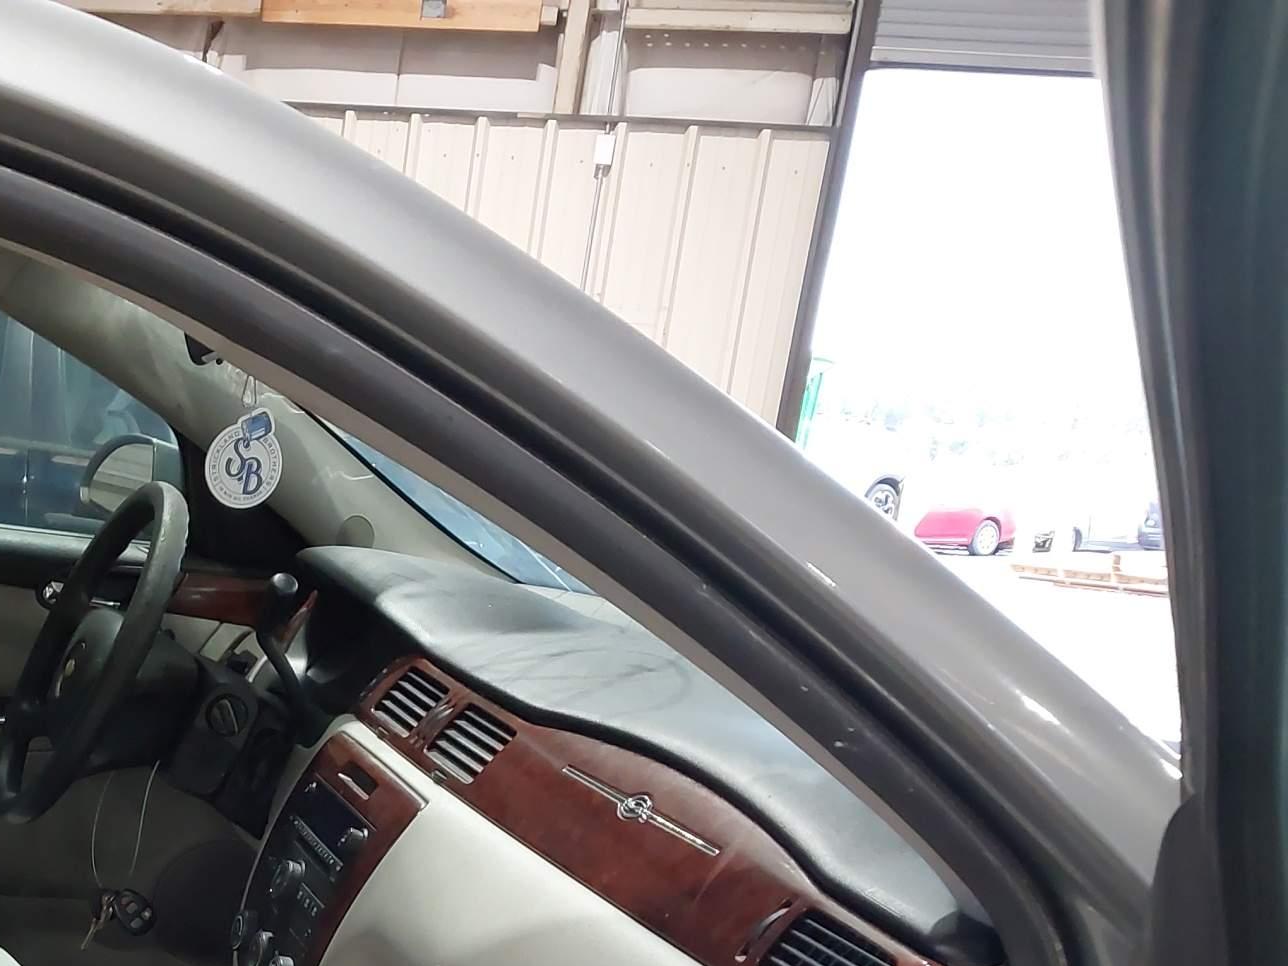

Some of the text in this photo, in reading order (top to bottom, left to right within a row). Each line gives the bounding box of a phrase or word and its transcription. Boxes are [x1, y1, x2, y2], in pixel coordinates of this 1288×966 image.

[210, 430, 241, 482] STRICKLAND
[225, 438, 263, 496] SB
[262, 438, 278, 486] BROTHERS
